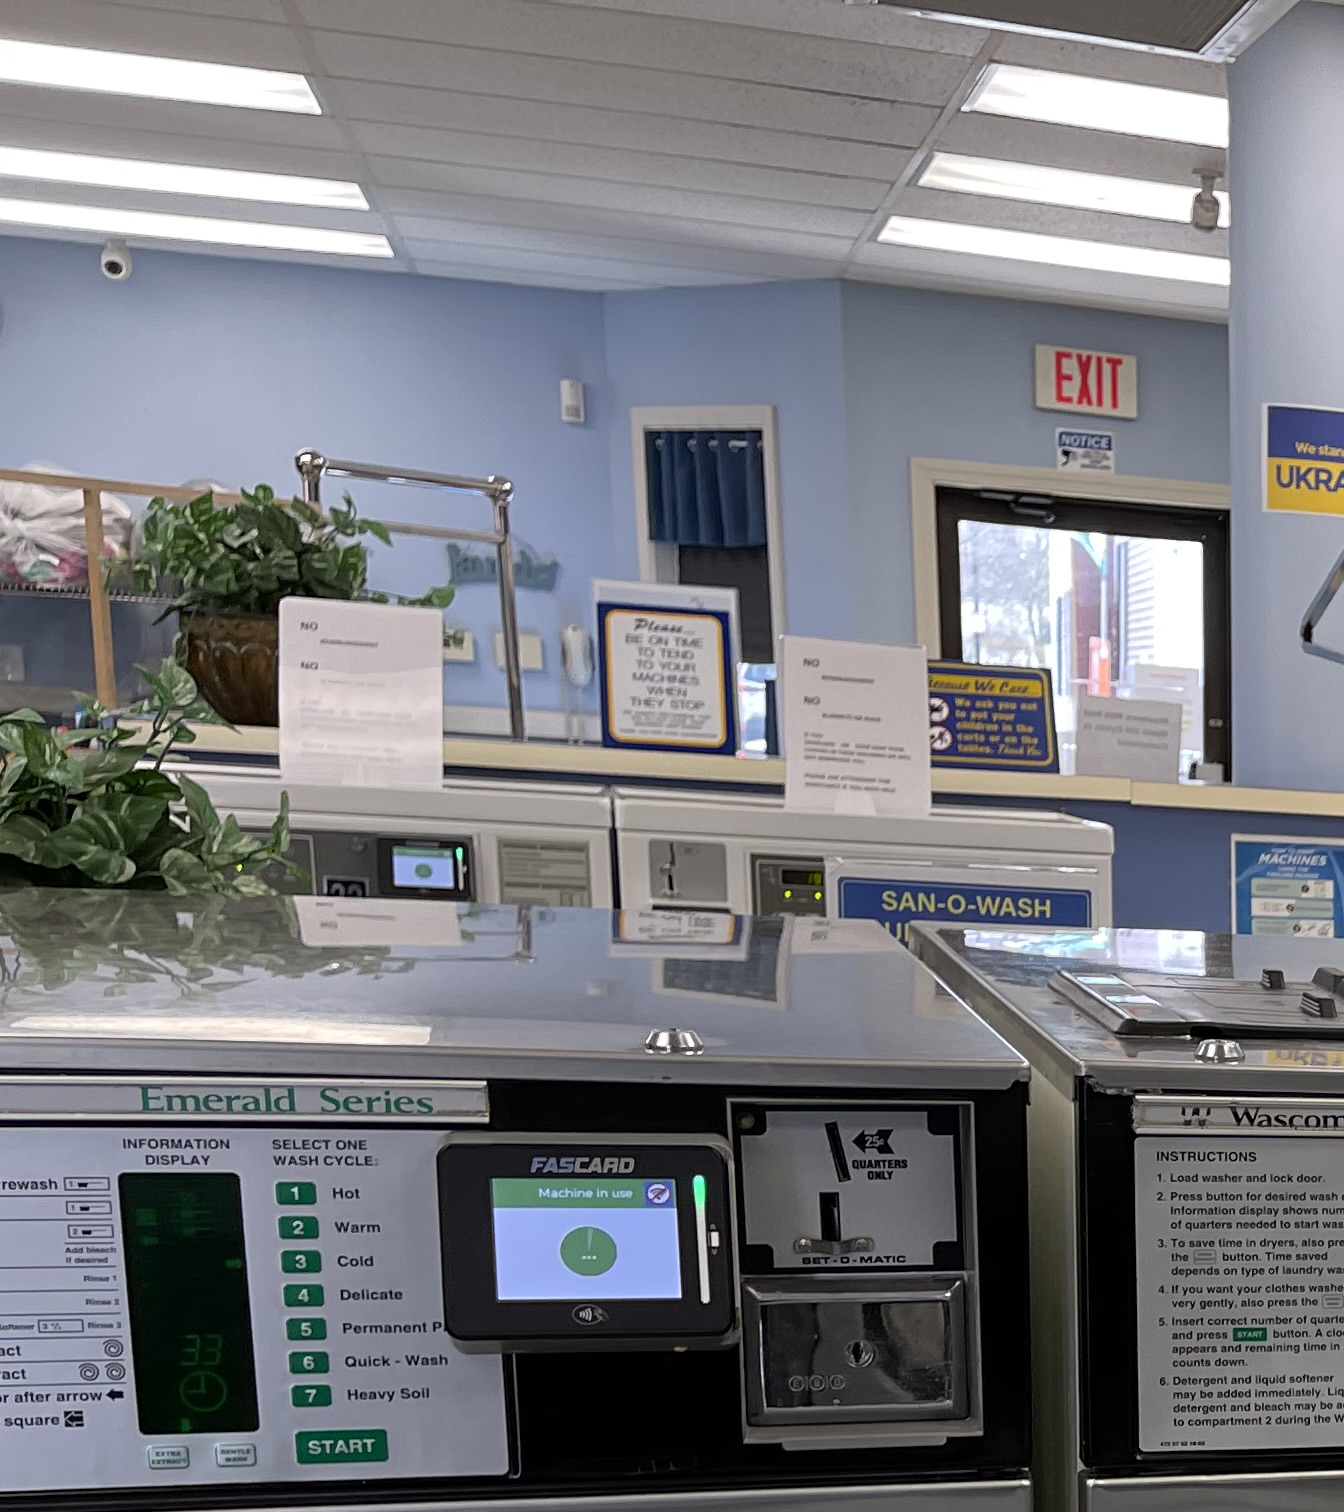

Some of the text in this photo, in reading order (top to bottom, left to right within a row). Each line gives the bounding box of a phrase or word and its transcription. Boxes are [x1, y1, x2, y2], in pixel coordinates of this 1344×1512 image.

[1054, 350, 1123, 410] EXIT
[1060, 433, 1110, 450] NOTICE
[1295, 441, 1316, 455] We
[1257, 853, 1328, 867] MACHINES
[881, 890, 1051, 918] SAN-O-WASH
[139, 1086, 434, 1116] Emerald Series
[122, 1138, 230, 1151] INFORMATION
[272, 1139, 367, 1151] SELECT ONE
[145, 1154, 211, 1167] DISPLAY
[273, 1155, 378, 1167] WASH CYCLE:
[1156, 1151, 1257, 1162] INSTRUCTIONS
[530, 1156, 635, 1174] FASCARD
[852, 1159, 908, 1170] QUARTERS
[867, 1170, 893, 1181] ONLY
[332, 1188, 360, 1200] Hot
[538, 1187, 633, 1200] Machine in use
[335, 1221, 381, 1234] Warm
[337, 1255, 374, 1267] Cold
[340, 1288, 403, 1302] Delicate
[347, 1386, 430, 1403] Heavy Soil
[308, 1438, 376, 1455] START
